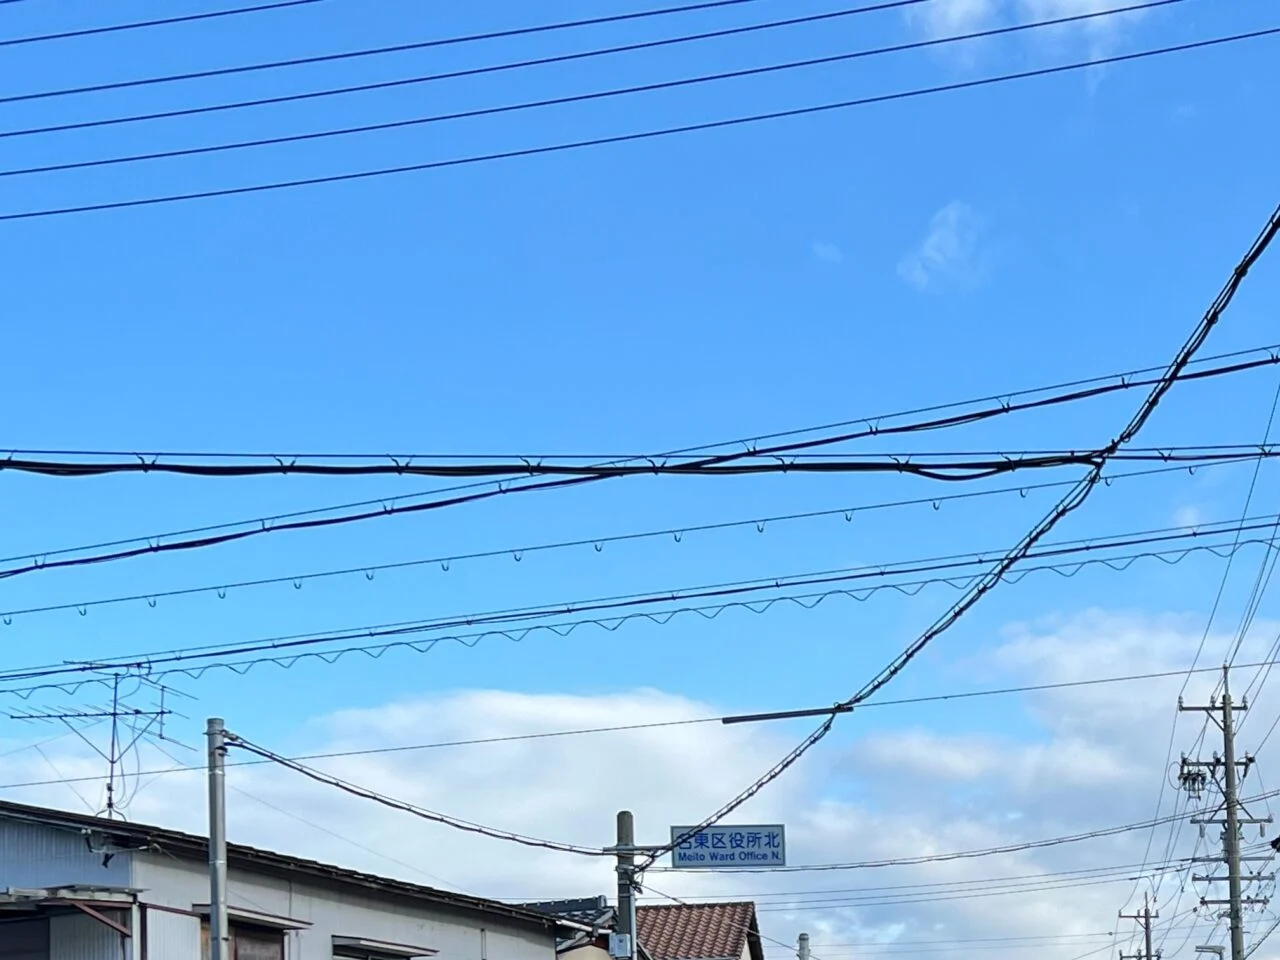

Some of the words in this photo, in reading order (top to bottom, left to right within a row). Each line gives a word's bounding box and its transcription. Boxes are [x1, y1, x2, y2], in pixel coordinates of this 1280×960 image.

[678, 852, 705, 861] Meito
[709, 852, 735, 861] Ward
[739, 851, 768, 860] Office
